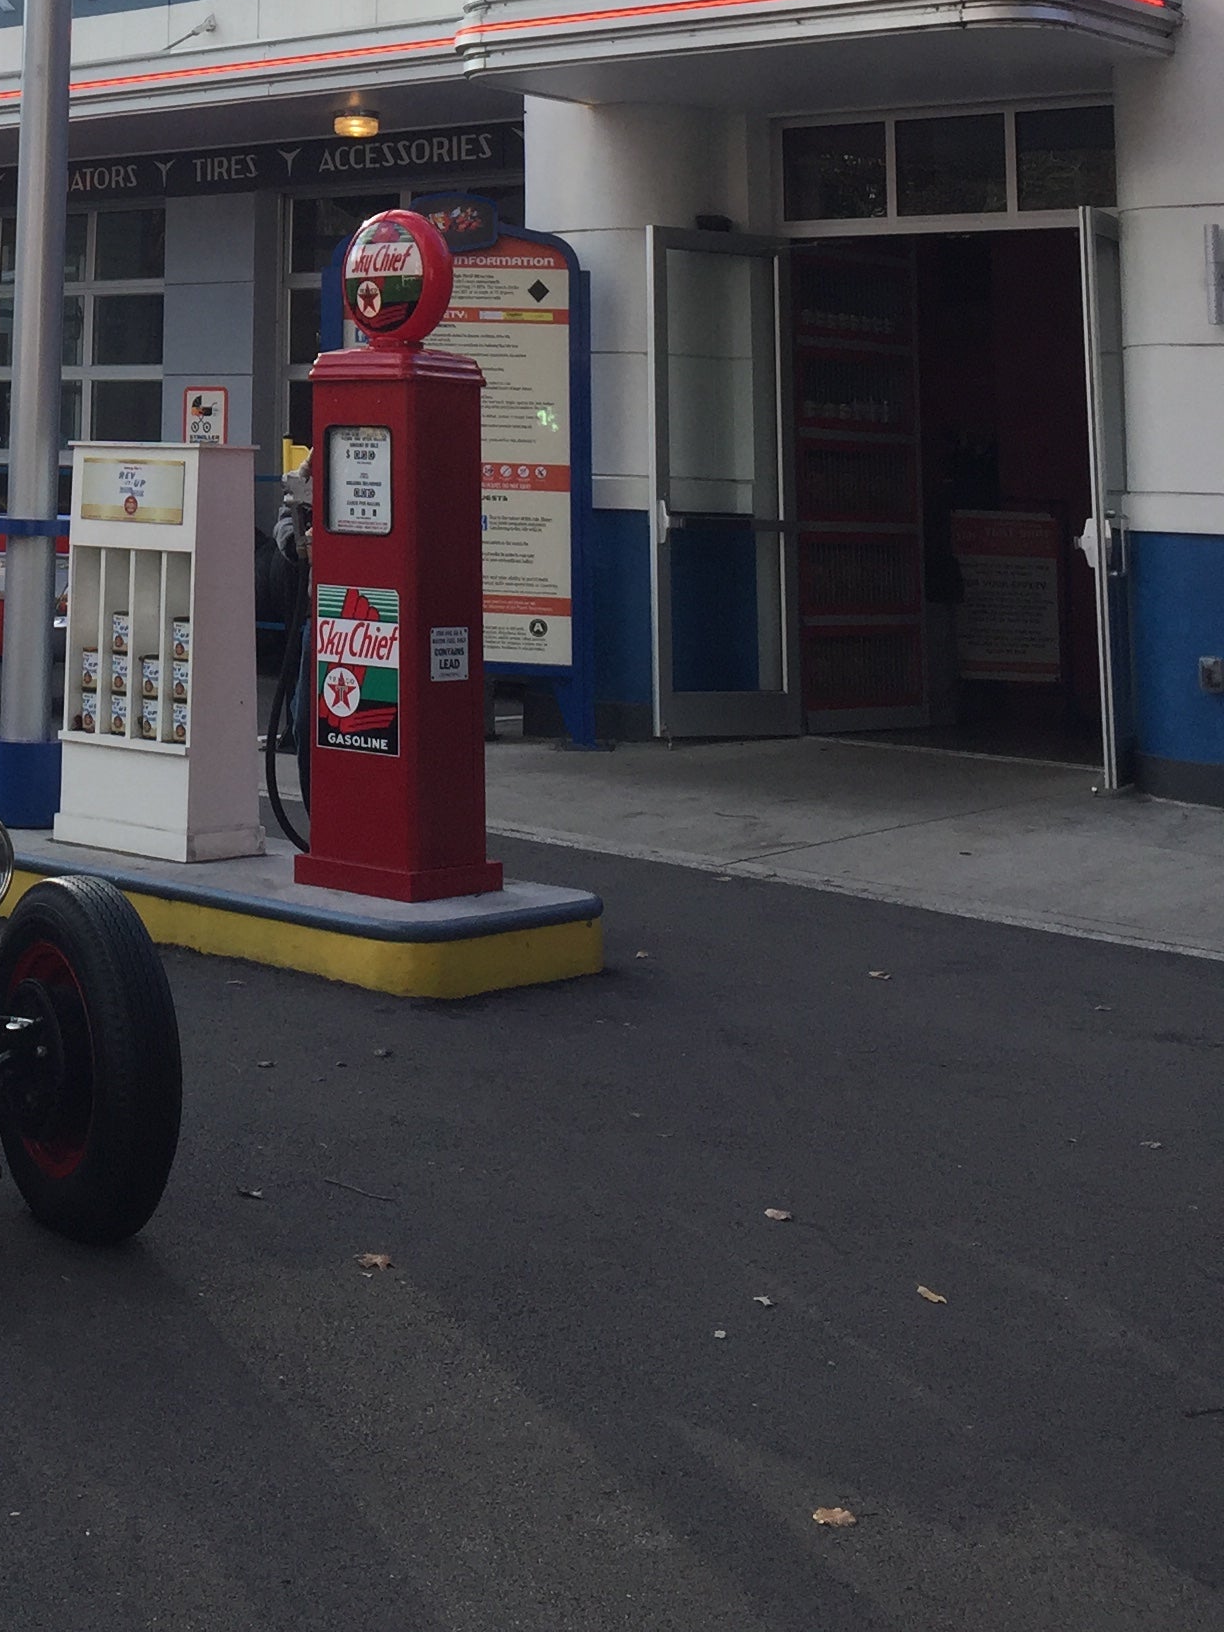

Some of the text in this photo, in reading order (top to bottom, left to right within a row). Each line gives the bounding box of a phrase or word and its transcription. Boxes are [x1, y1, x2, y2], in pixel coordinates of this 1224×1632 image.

[67, 163, 138, 192] ATORS
[192, 154, 259, 183] TIRES
[318, 132, 493, 173] ACCESSORIES
[372, 244, 414, 273] Chief
[454, 255, 555, 267] INFORMATION
[317, 619, 399, 665] Sky Chief
[439, 658, 461, 670] LEAD
[327, 732, 389, 751] GASOLINE
